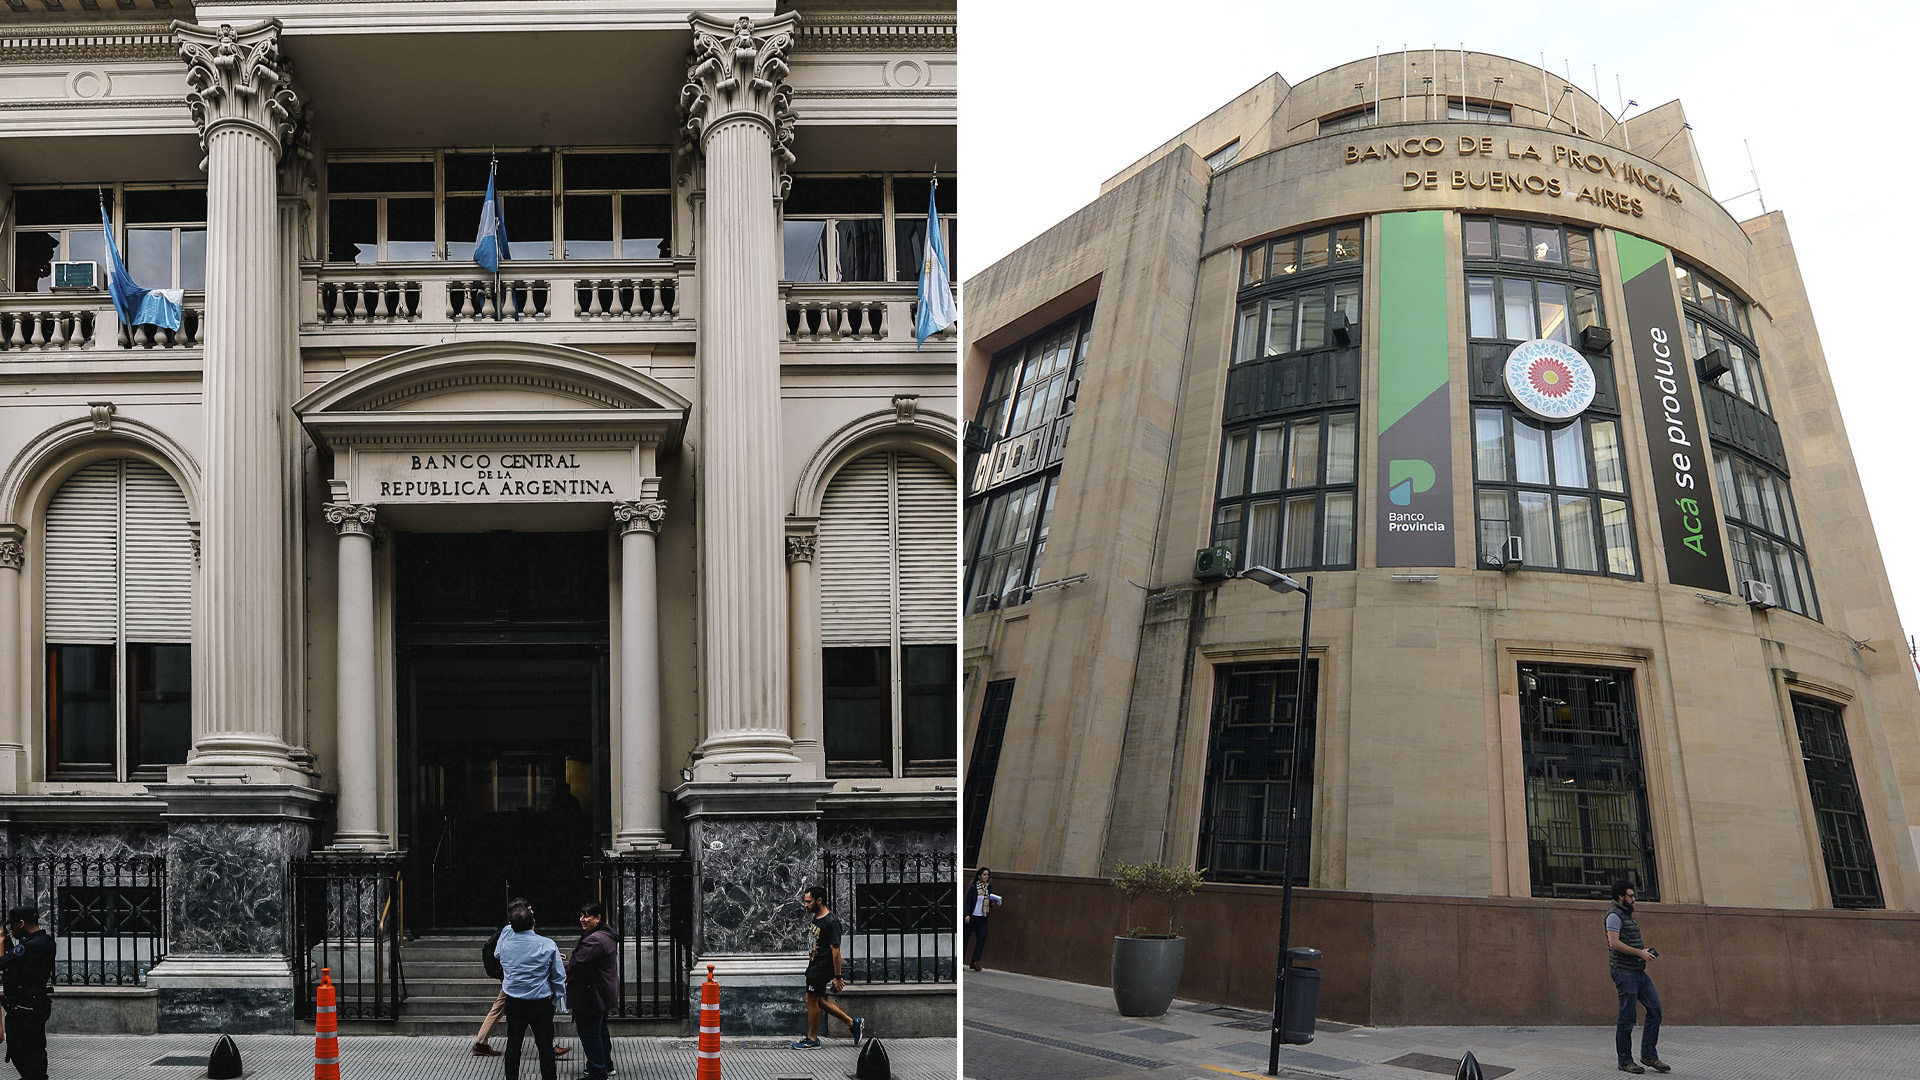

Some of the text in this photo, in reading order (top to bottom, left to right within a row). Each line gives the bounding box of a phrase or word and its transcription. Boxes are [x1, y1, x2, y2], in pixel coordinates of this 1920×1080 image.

[1345, 136, 1683, 204] BANCO DE LA PROVINCIA
[1403, 170, 1644, 217] DE BUENOS AIRES
[1650, 327, 1708, 557] Acá se produce
[411, 454, 580, 470] BANCO CENTRAL
[478, 470, 512, 479] DE LA
[381, 480, 614, 496] REPUBLICA ARGENTINA
[1389, 512, 1424, 522] Banco
[1389, 522, 1445, 532] Provincia
